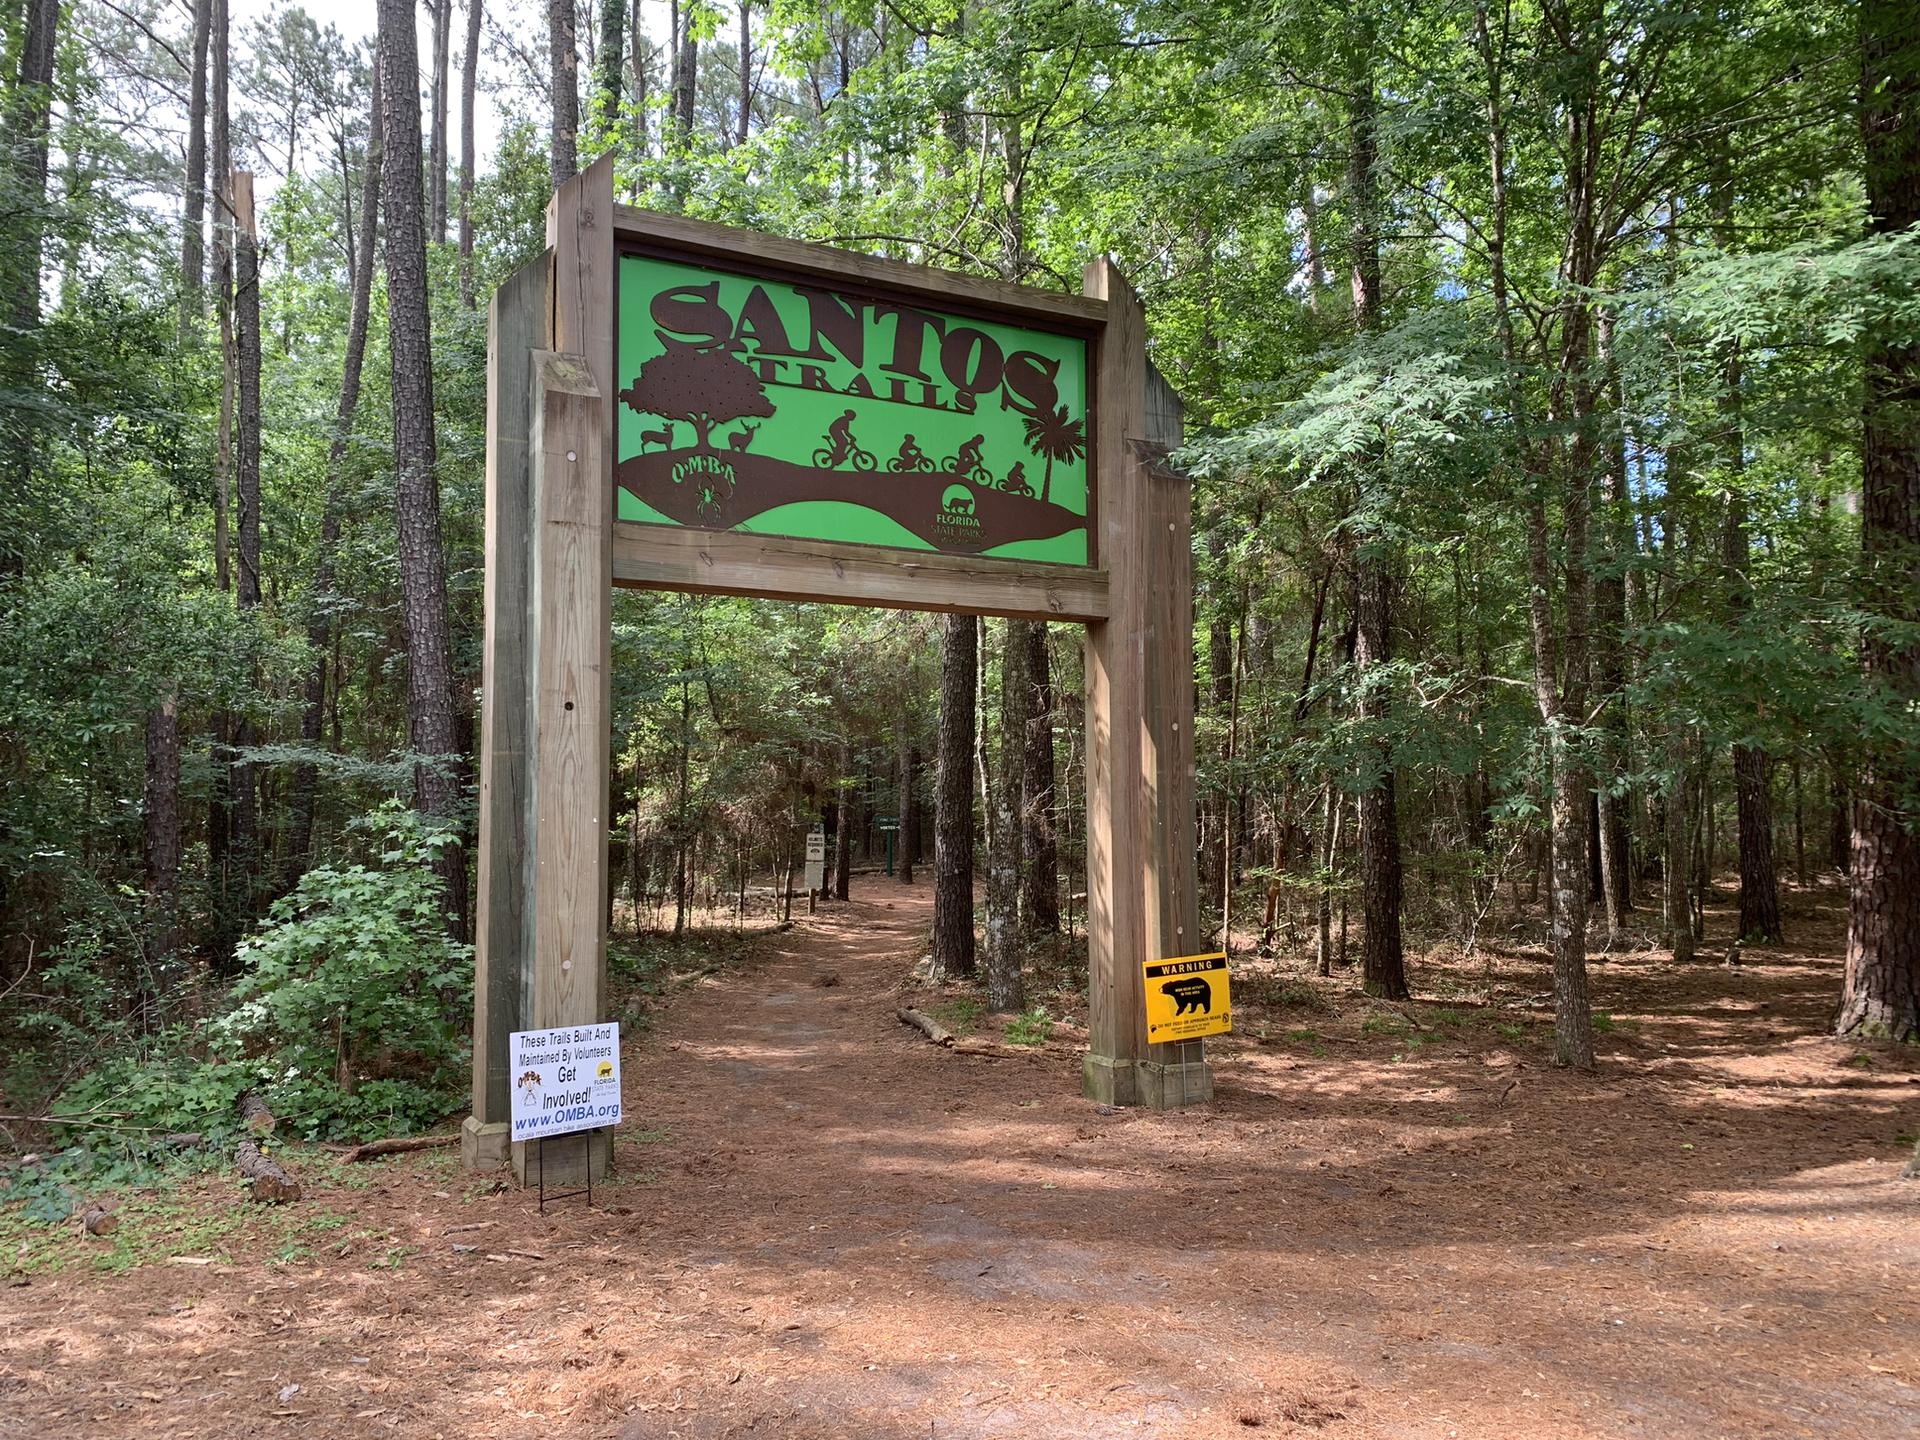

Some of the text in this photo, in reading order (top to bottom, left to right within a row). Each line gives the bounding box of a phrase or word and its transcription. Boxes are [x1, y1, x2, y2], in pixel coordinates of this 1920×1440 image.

[650, 280, 1063, 418] SANTOS
[747, 356, 977, 415] TRAILS
[936, 513, 981, 527] FLORIDA
[1161, 960, 1213, 975] WARNING
[520, 1027, 611, 1049] These Trails Built And
[519, 1046, 612, 1067] Maintained By Volunteers
[558, 1066, 577, 1083] Get
[594, 1077, 616, 1086] FLORIDA
[542, 1086, 592, 1110] Involved!
[515, 1103, 619, 1130] www.OMBA.org
[535, 1126, 562, 1136] mountain
[563, 1124, 576, 1133] bike
